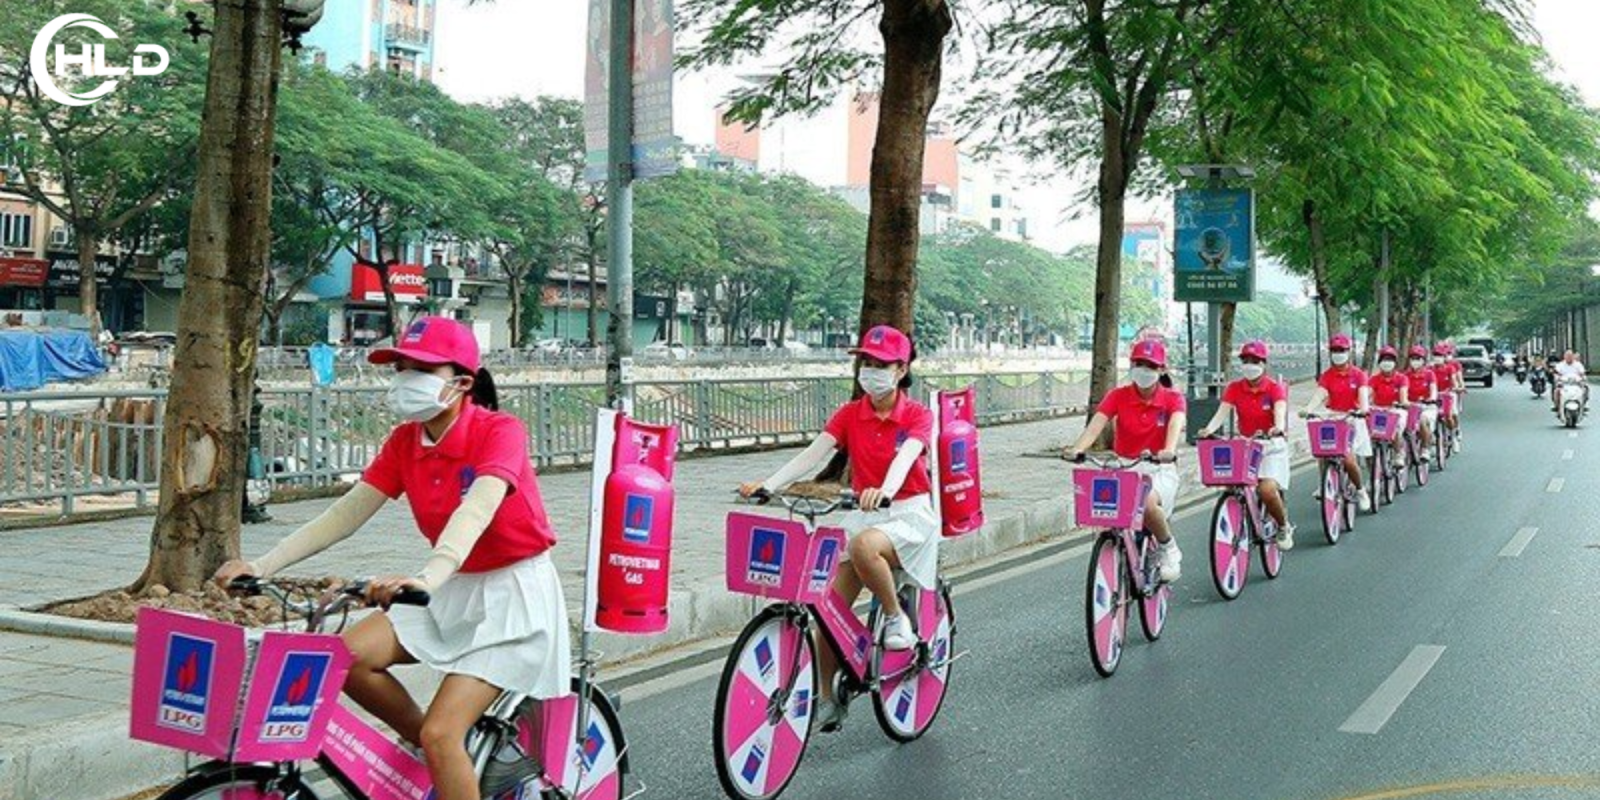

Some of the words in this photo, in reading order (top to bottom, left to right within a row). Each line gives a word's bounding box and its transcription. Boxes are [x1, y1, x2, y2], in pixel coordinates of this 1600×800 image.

[625, 572, 644, 585] GAS
[163, 708, 202, 729] LPG
[264, 724, 303, 737] LPG
